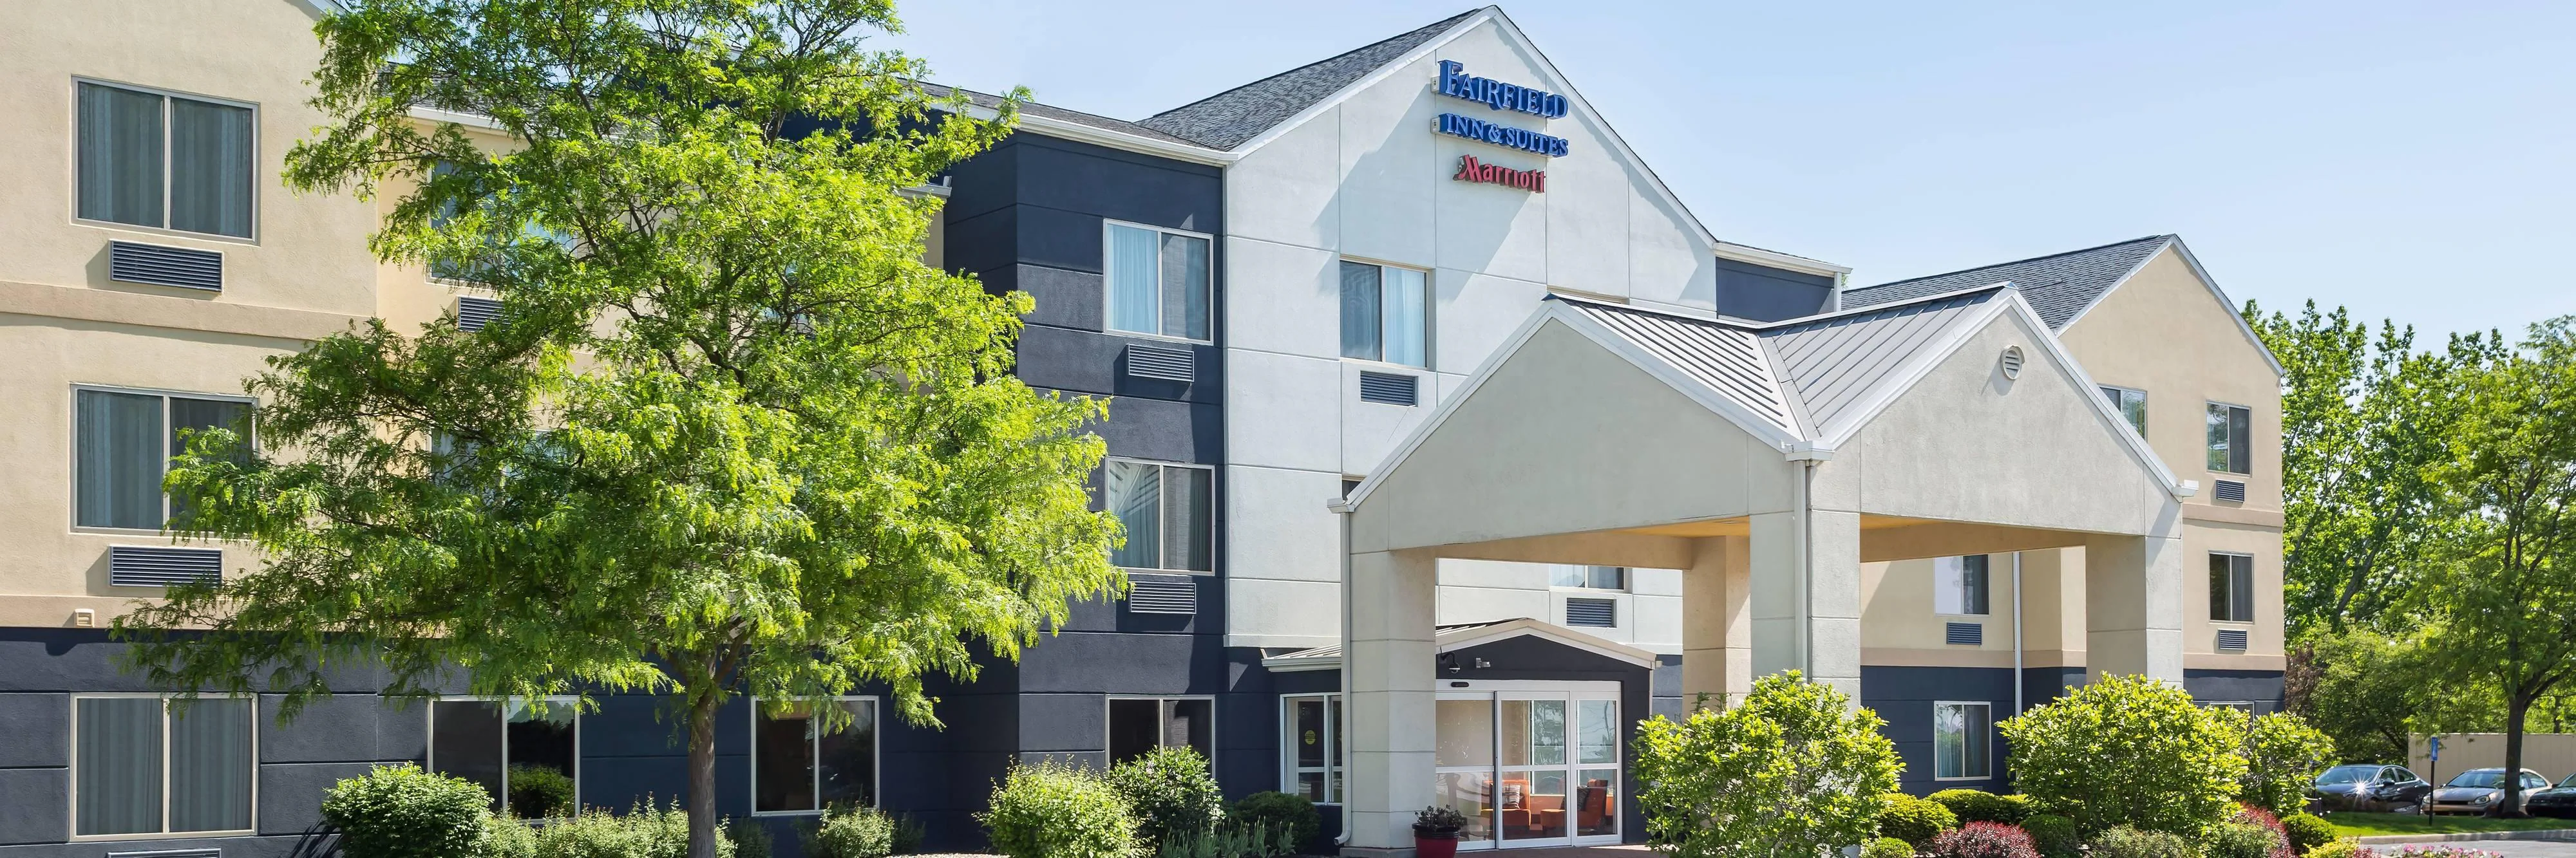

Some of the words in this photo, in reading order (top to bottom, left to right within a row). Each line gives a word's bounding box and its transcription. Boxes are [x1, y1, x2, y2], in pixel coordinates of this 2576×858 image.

[1438, 60, 1569, 120] FAIRFIELD
[1441, 113, 1486, 140] INN
[1488, 124, 1503, 144] &
[1506, 127, 1569, 158] SUITES
[1454, 154, 1546, 193] Marriott
